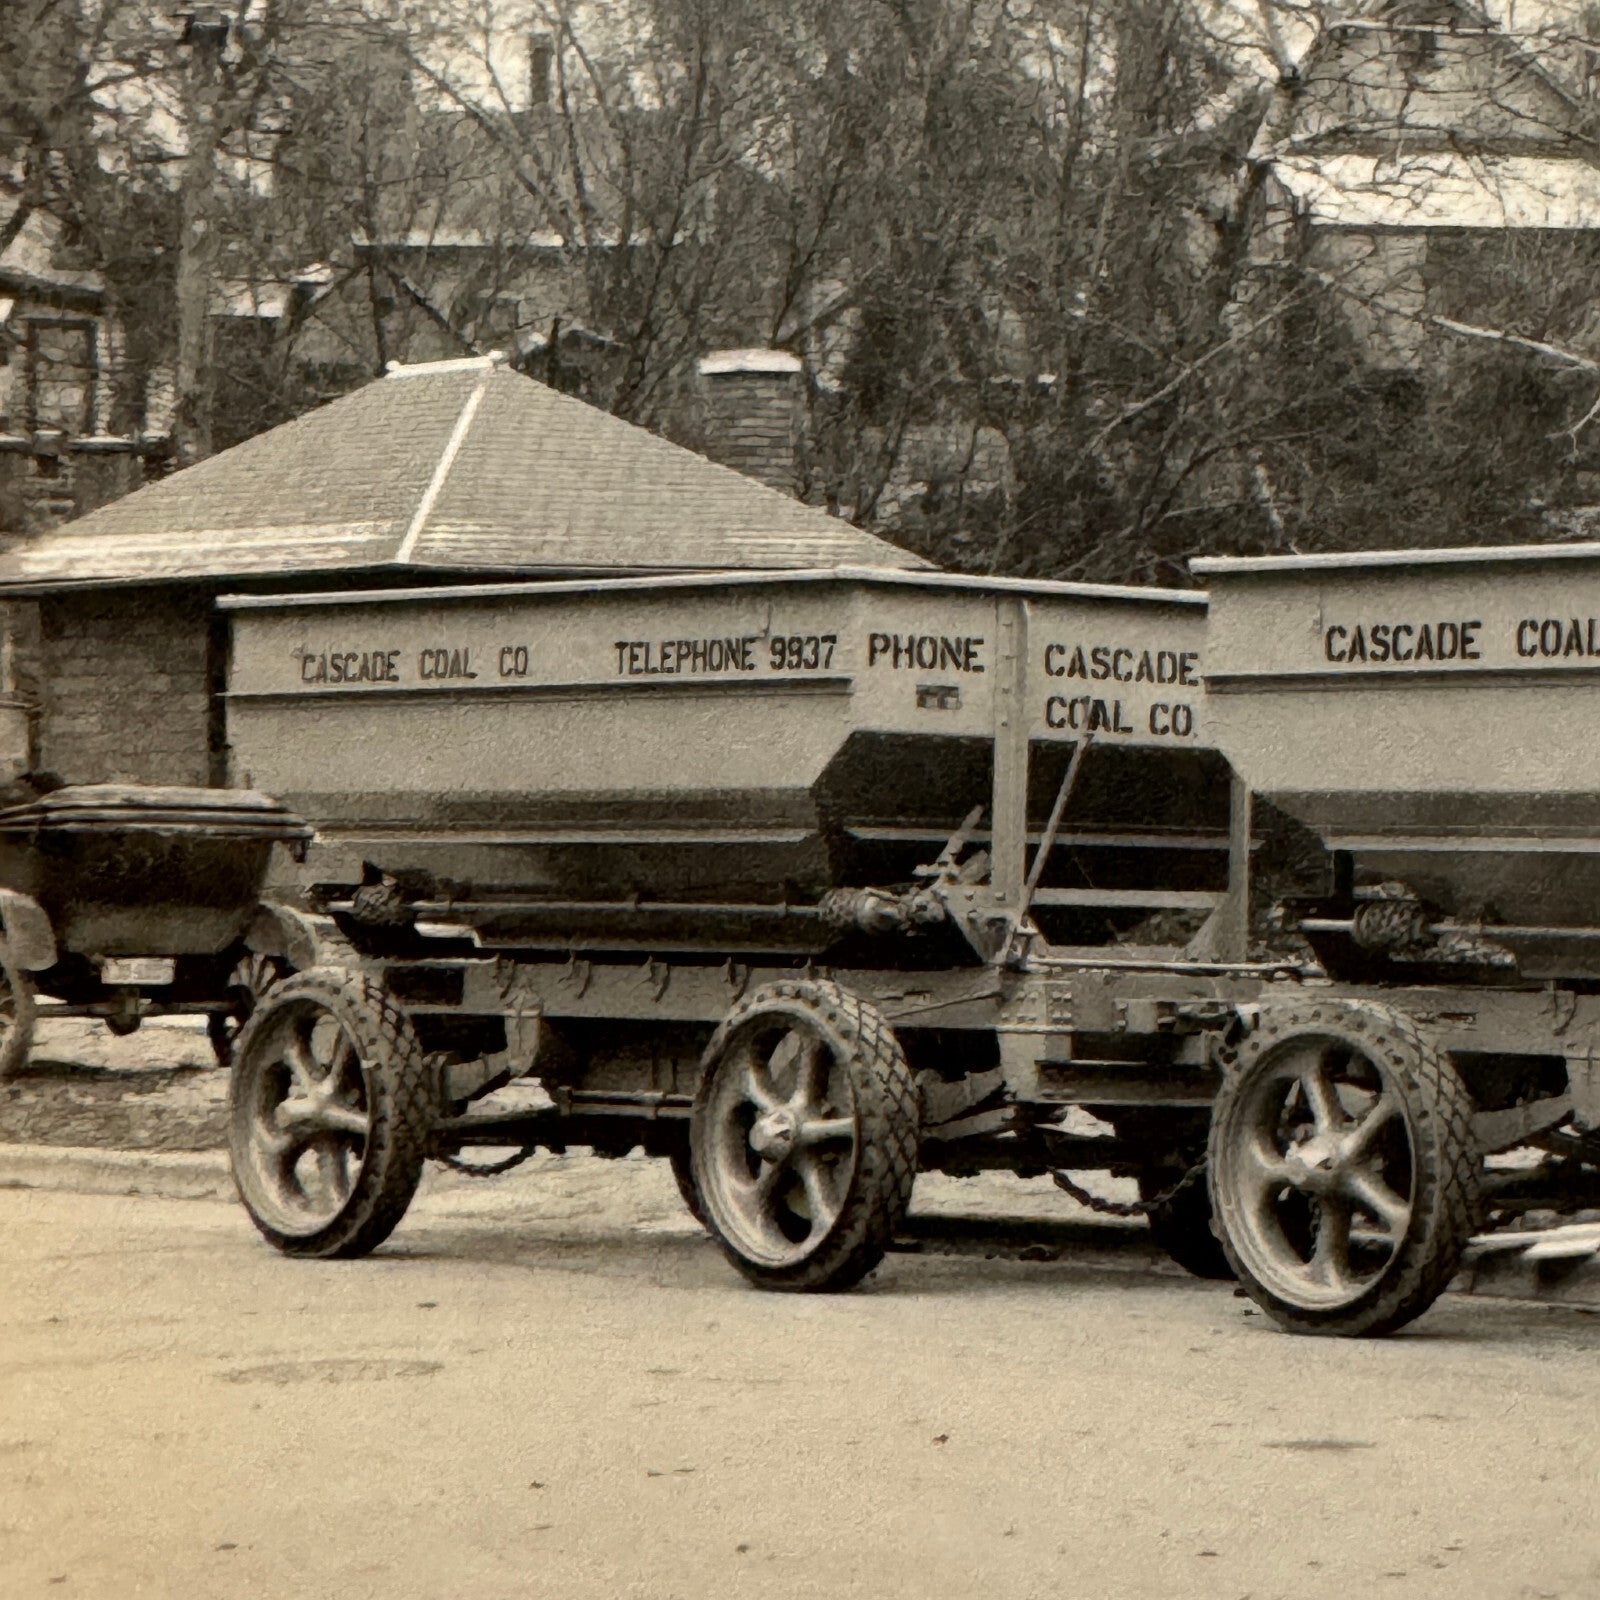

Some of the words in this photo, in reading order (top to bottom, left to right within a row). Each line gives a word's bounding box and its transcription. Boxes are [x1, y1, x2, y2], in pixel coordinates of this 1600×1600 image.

[615, 636, 758, 675] TELEPHONE
[769, 634, 837, 670] 9937
[868, 633, 985, 673] PHONE
[1324, 620, 1482, 663] CASCADE
[1516, 617, 1600, 659] COAL
[302, 650, 400, 684] CASCADE
[420, 647, 478, 680] COAL
[500, 646, 529, 678] CO
[1044, 643, 1199, 686] CASCADE
[1046, 695, 1133, 734] COAL
